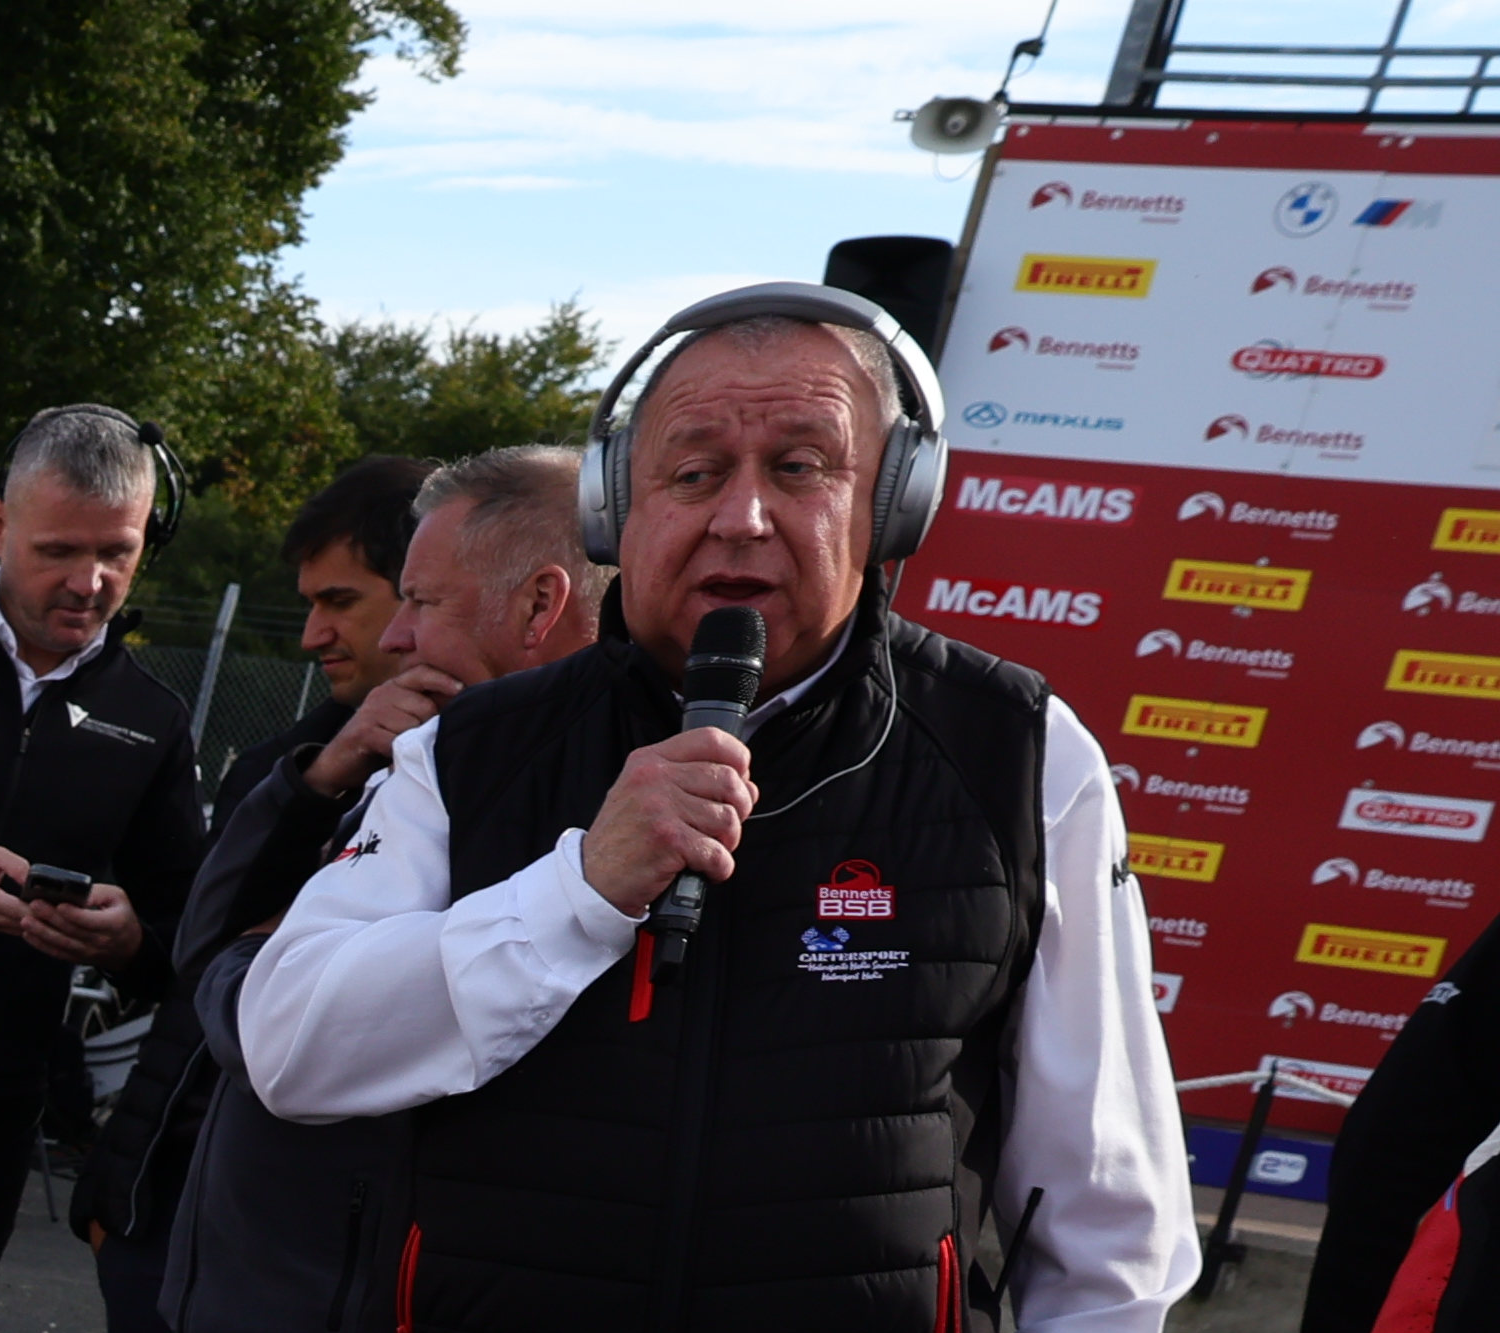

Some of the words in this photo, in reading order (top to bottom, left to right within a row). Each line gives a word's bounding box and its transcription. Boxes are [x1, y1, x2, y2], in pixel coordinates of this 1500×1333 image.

[1080, 190, 1185, 214] Bennetts
[1237, 350, 1376, 377] QUATTRO
[956, 477, 1134, 522] McAMS
[1229, 503, 1339, 530] Bennetts
[925, 578, 1102, 625] McAMS
[1145, 774, 1250, 805] Bennetts
[819, 887, 892, 899] Bennetts
[819, 899, 892, 917] BSB
